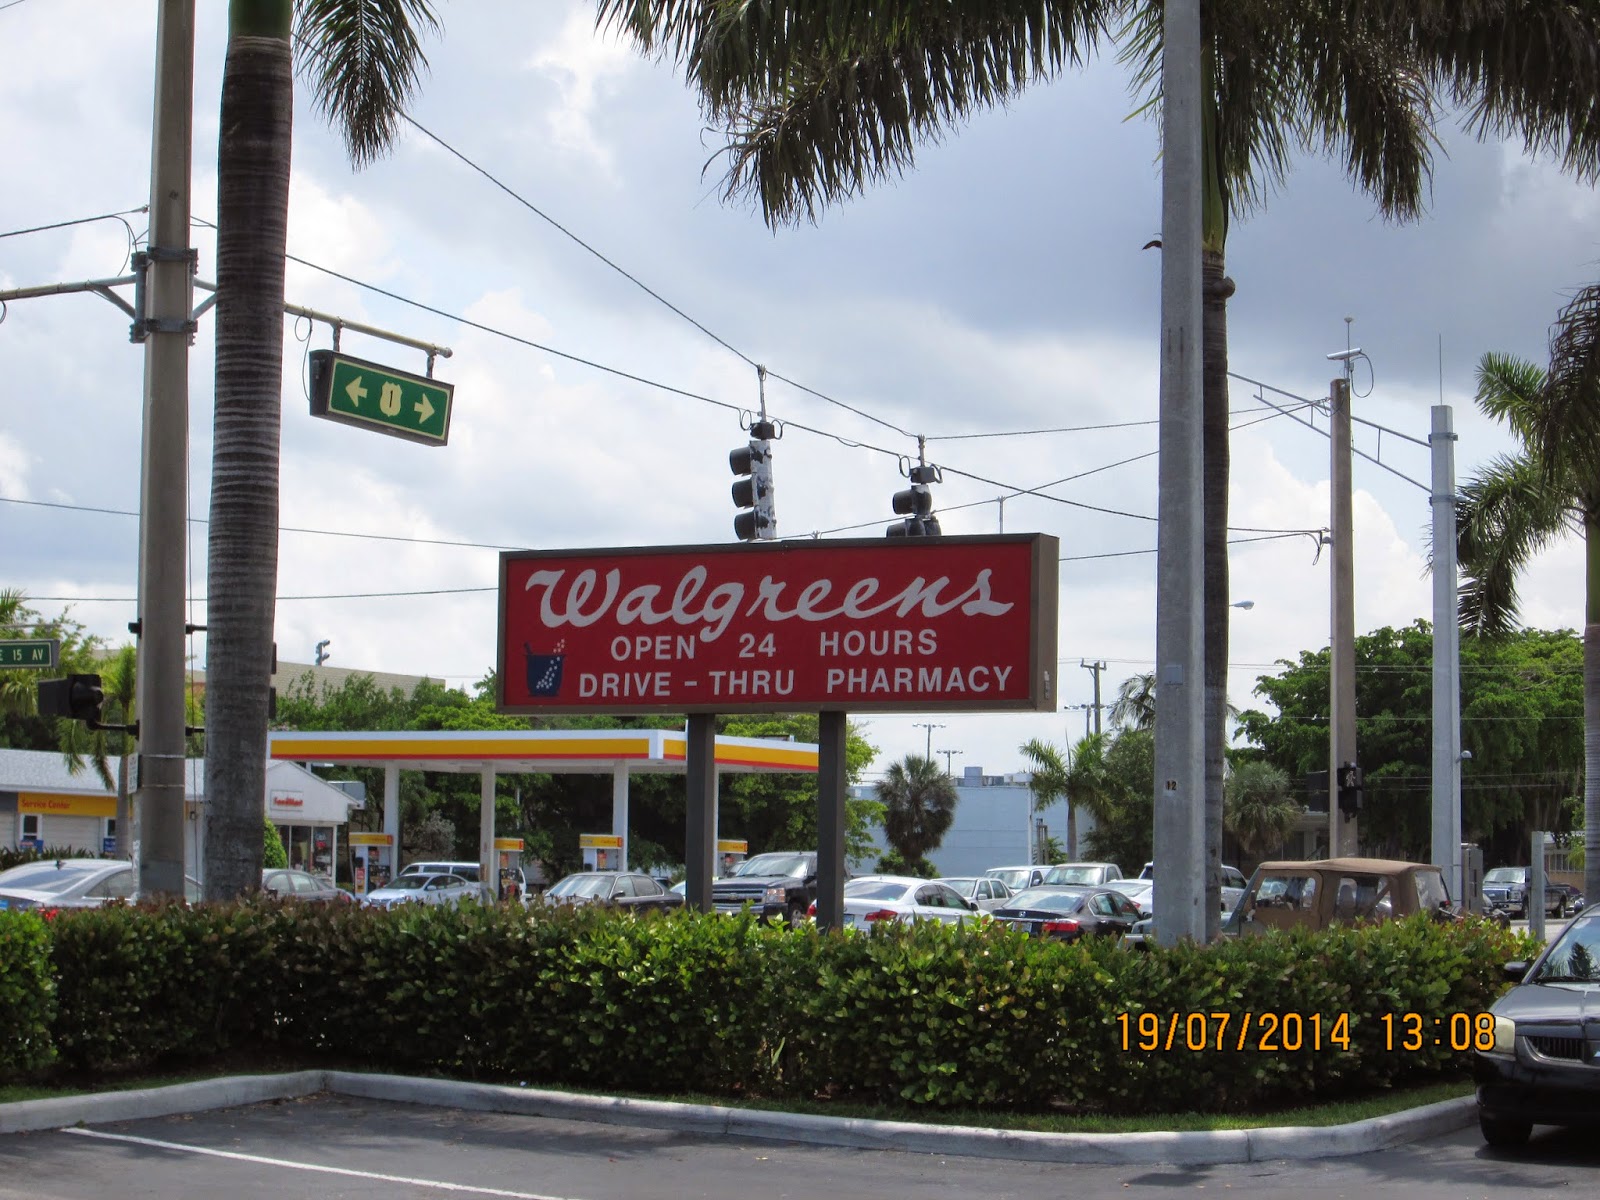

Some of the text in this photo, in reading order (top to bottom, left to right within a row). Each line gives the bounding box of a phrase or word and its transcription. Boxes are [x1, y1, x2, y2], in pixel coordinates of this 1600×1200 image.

[525, 564, 1014, 642] Walgreens
[13, 649, 23, 662] 15
[32, 648, 44, 661] AV
[610, 628, 939, 662] OPEN 24 HOURS
[578, 670, 672, 699] DRIVE
[708, 669, 795, 696] THRU
[826, 666, 1013, 694] PHARMACY
[21, 799, 71, 810] Service Center
